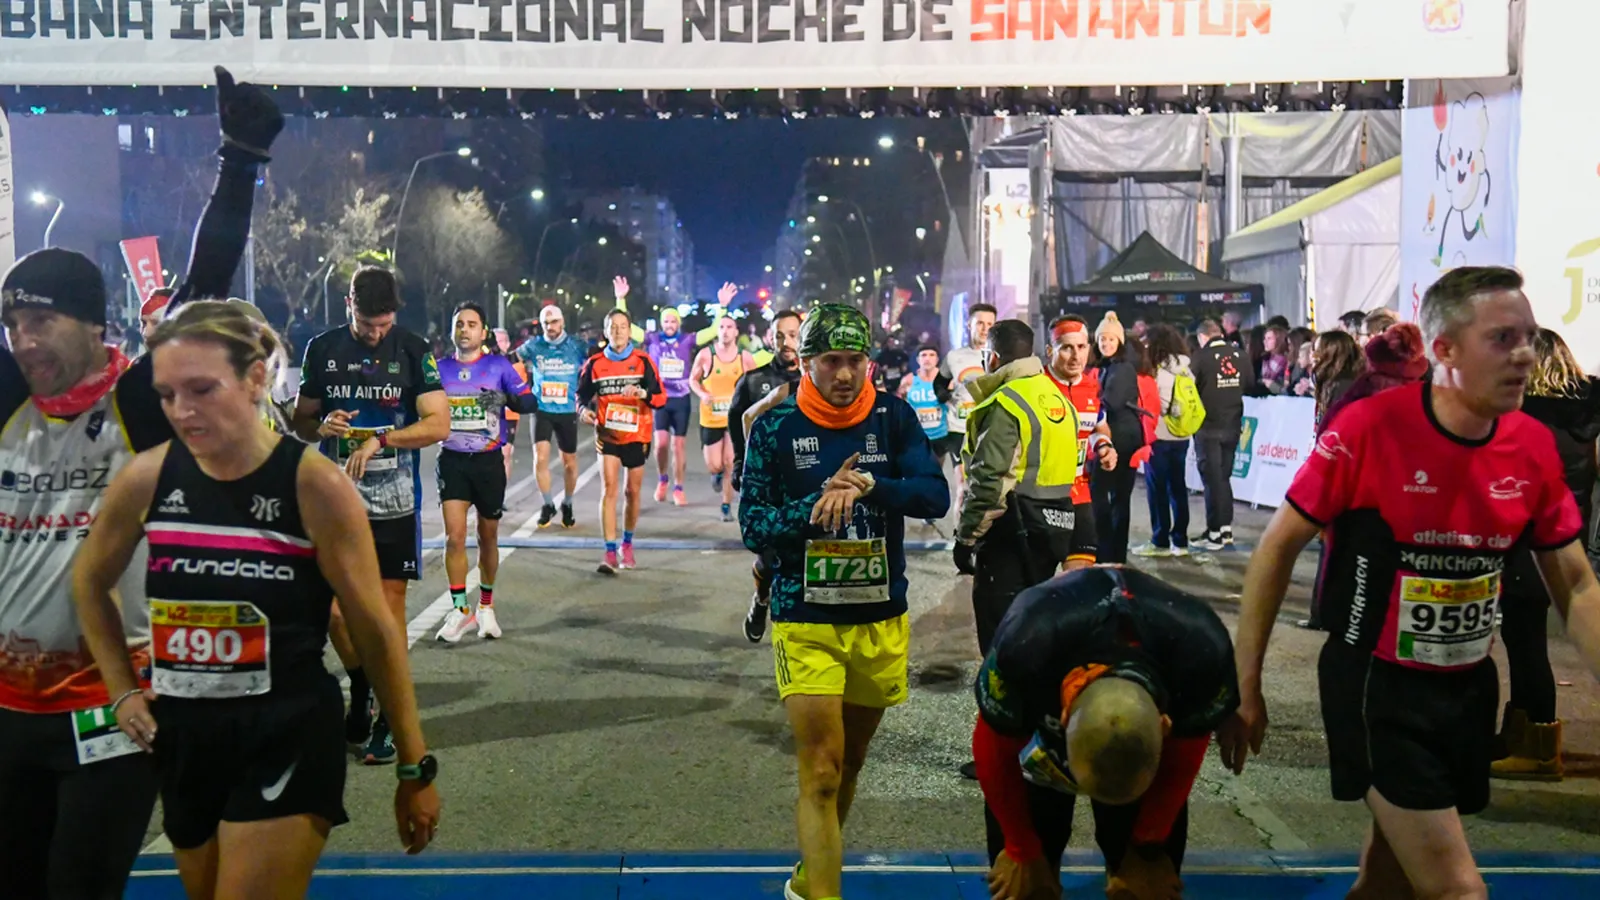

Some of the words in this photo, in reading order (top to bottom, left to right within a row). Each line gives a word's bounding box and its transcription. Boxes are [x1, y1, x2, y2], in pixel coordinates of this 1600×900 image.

[170, 0, 664, 43] INTERNACIONAL
[682, 0, 865, 43] NOCHE
[883, 0, 953, 41] DE
[970, 0, 1078, 41] SAN
[326, 385, 351, 398] SAN
[355, 383, 402, 400] ANTÓN
[857, 454, 887, 463] SEGOVIA
[1413, 529, 1483, 546] atletismo
[813, 556, 883, 580] 1726
[1411, 598, 1495, 634] 9595
[166, 627, 243, 663] 490
